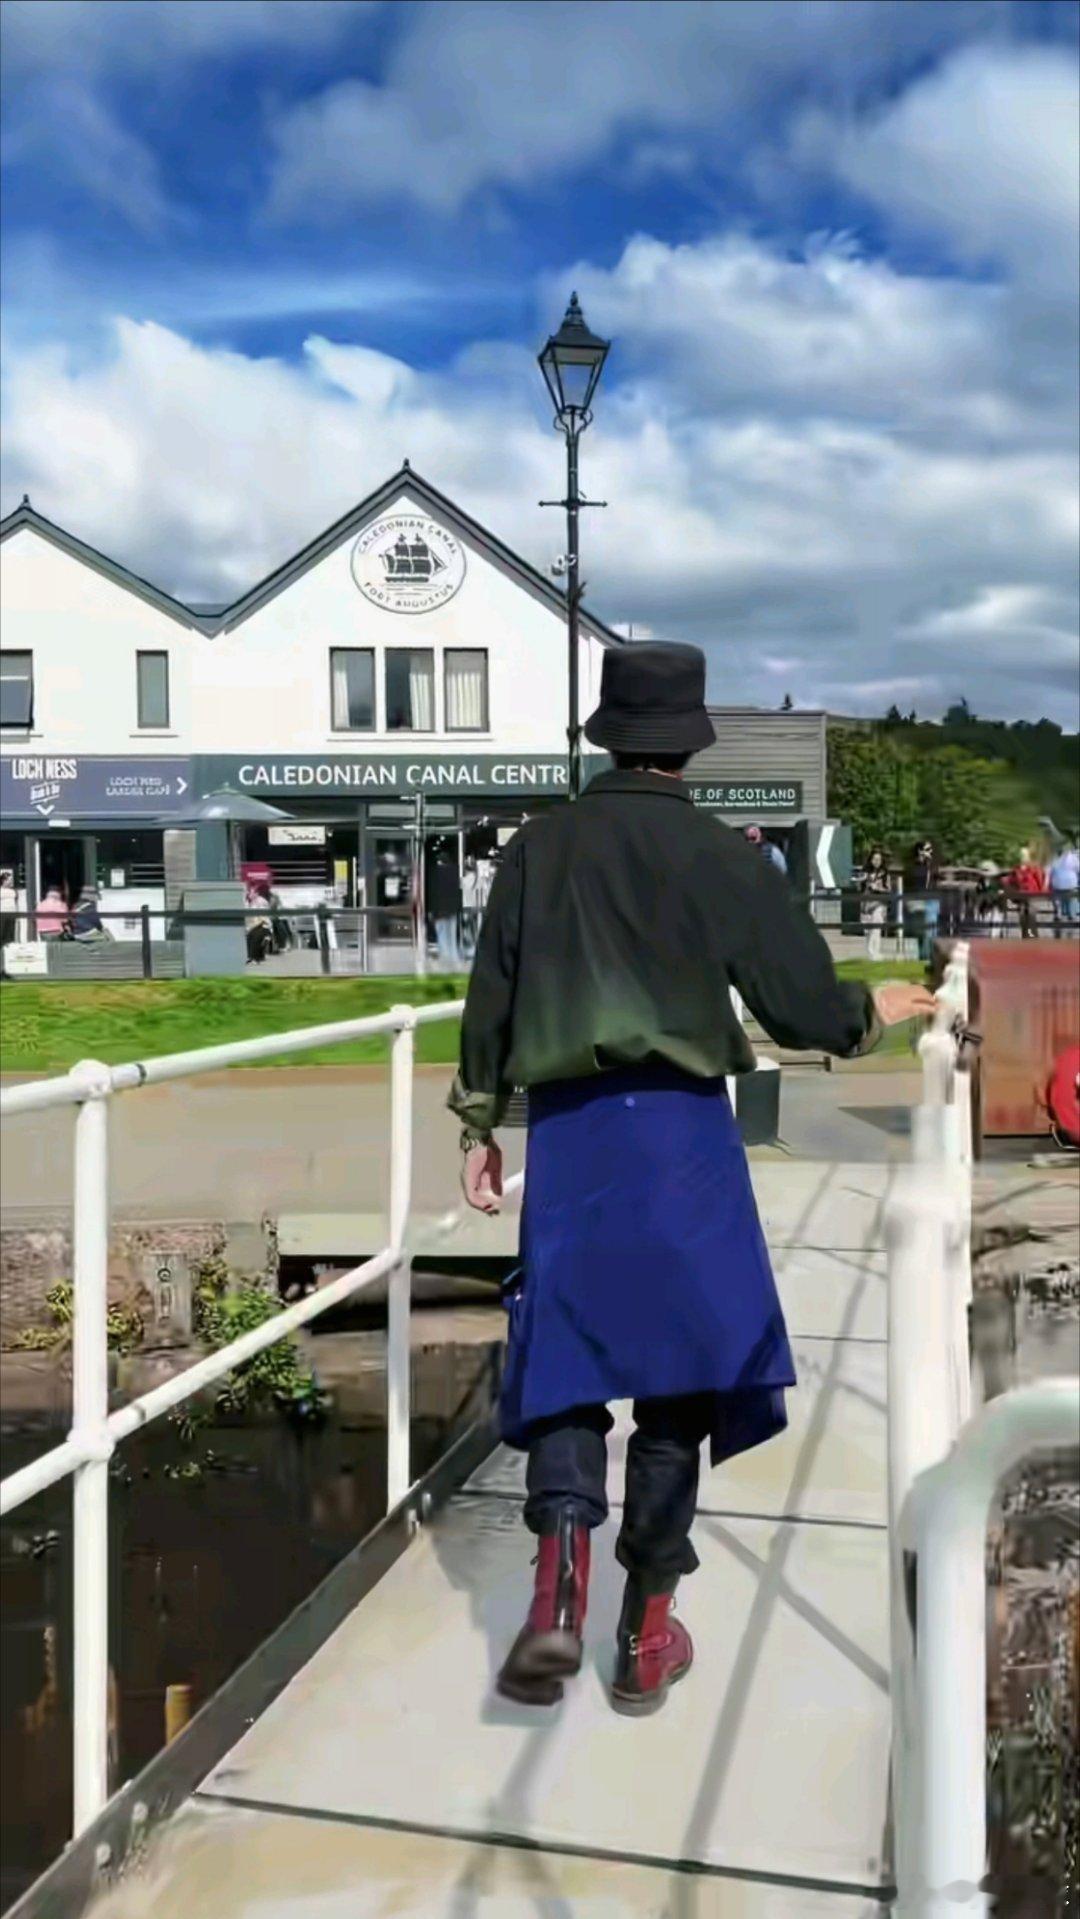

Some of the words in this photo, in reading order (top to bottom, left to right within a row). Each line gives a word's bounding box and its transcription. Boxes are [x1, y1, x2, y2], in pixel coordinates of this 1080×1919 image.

[359, 520, 424, 554] CALEDONIAN
[12, 759, 43, 779] LOCH
[46, 759, 77, 779] NESS
[238, 765, 397, 785] CALEDONIAN
[405, 765, 485, 785] CANAL
[491, 765, 567, 785] CENTR
[706, 788, 723, 800] OF
[728, 788, 796, 800] SCOTLAND
